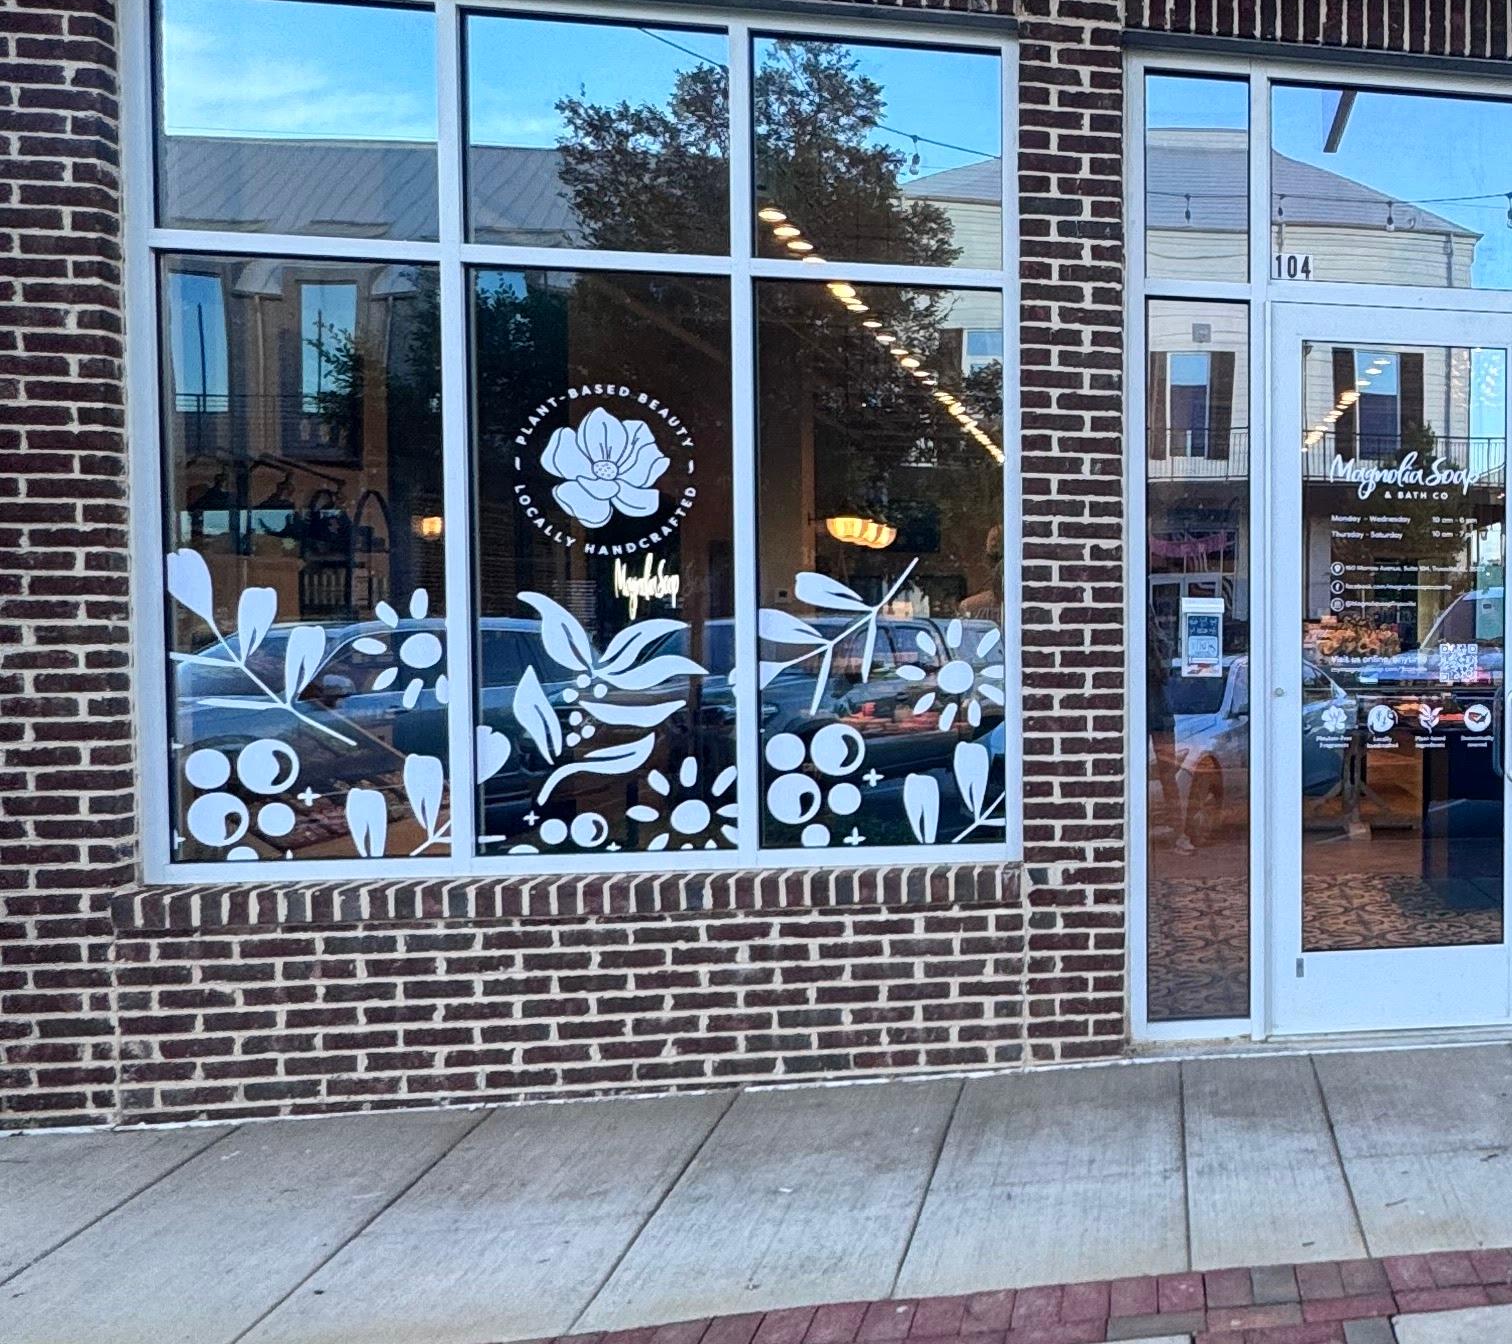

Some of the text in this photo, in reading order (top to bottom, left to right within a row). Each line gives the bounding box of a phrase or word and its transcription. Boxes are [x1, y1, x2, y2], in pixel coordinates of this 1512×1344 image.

[1275, 254, 1311, 280] 104
[515, 383, 694, 448] PLANT-BASED BEAUTY
[1329, 451, 1480, 500] Magnolia Soap
[1384, 491, 1449, 500] & BATH CO
[514, 484, 697, 556] LOCALLY HANDCRAFTED
[1331, 514, 1361, 524] Monday
[1369, 515, 1411, 525] Wednesday
[1331, 530, 1364, 540] Thursday
[1370, 531, 1403, 540] Saturday
